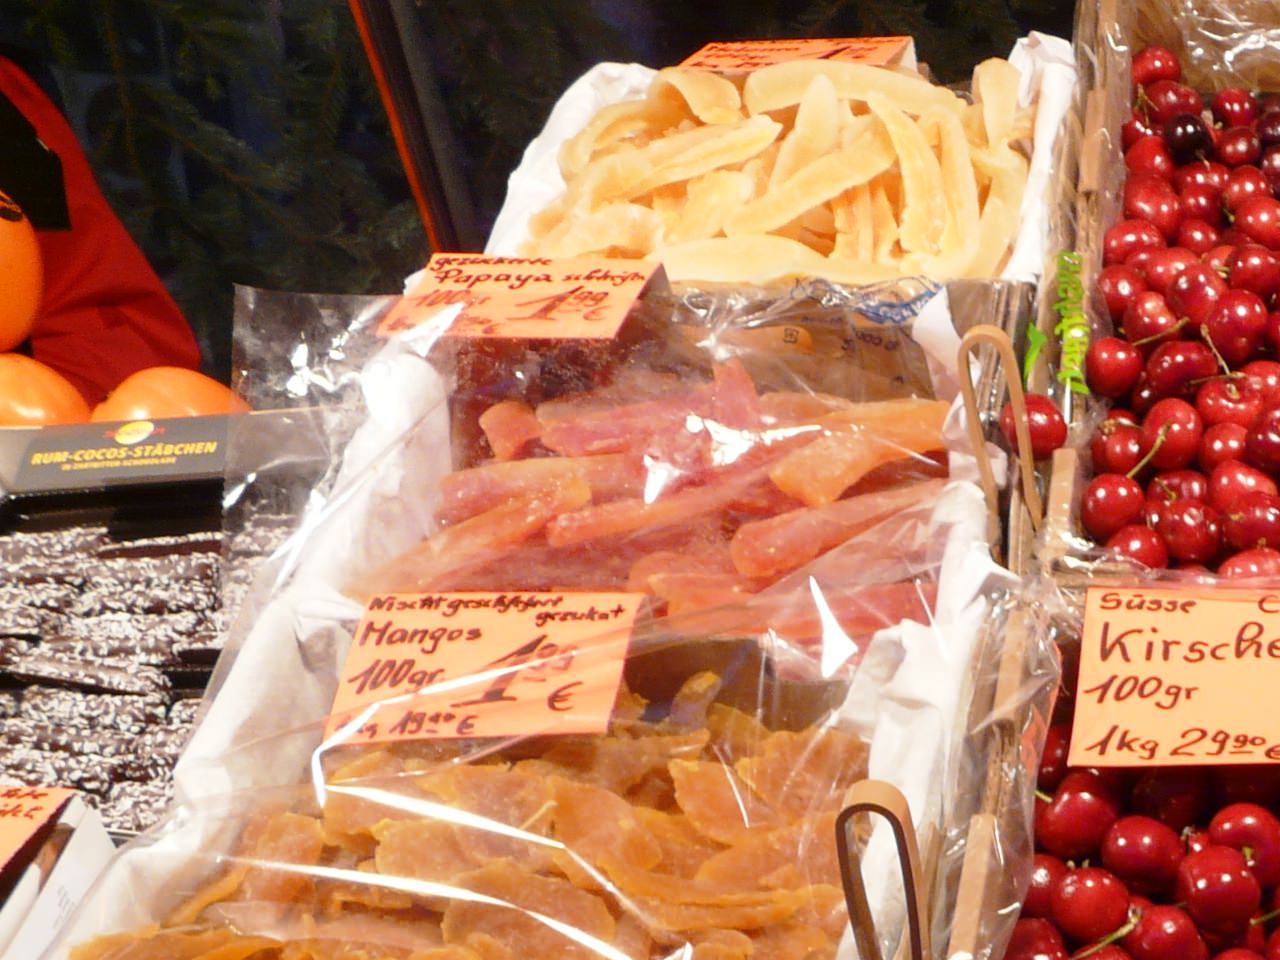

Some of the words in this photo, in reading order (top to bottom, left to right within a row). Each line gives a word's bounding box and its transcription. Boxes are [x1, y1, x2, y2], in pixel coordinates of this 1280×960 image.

[434, 267, 554, 291] Papaya
[31, 441, 218, 466] RUM-COCOS-STÄBCHEN
[1099, 592, 1198, 614] Süsse
[358, 620, 483, 654] Mangos
[546, 680, 585, 713] €
[1083, 673, 1200, 711] 100gr
[1085, 724, 1161, 761] 1kg
